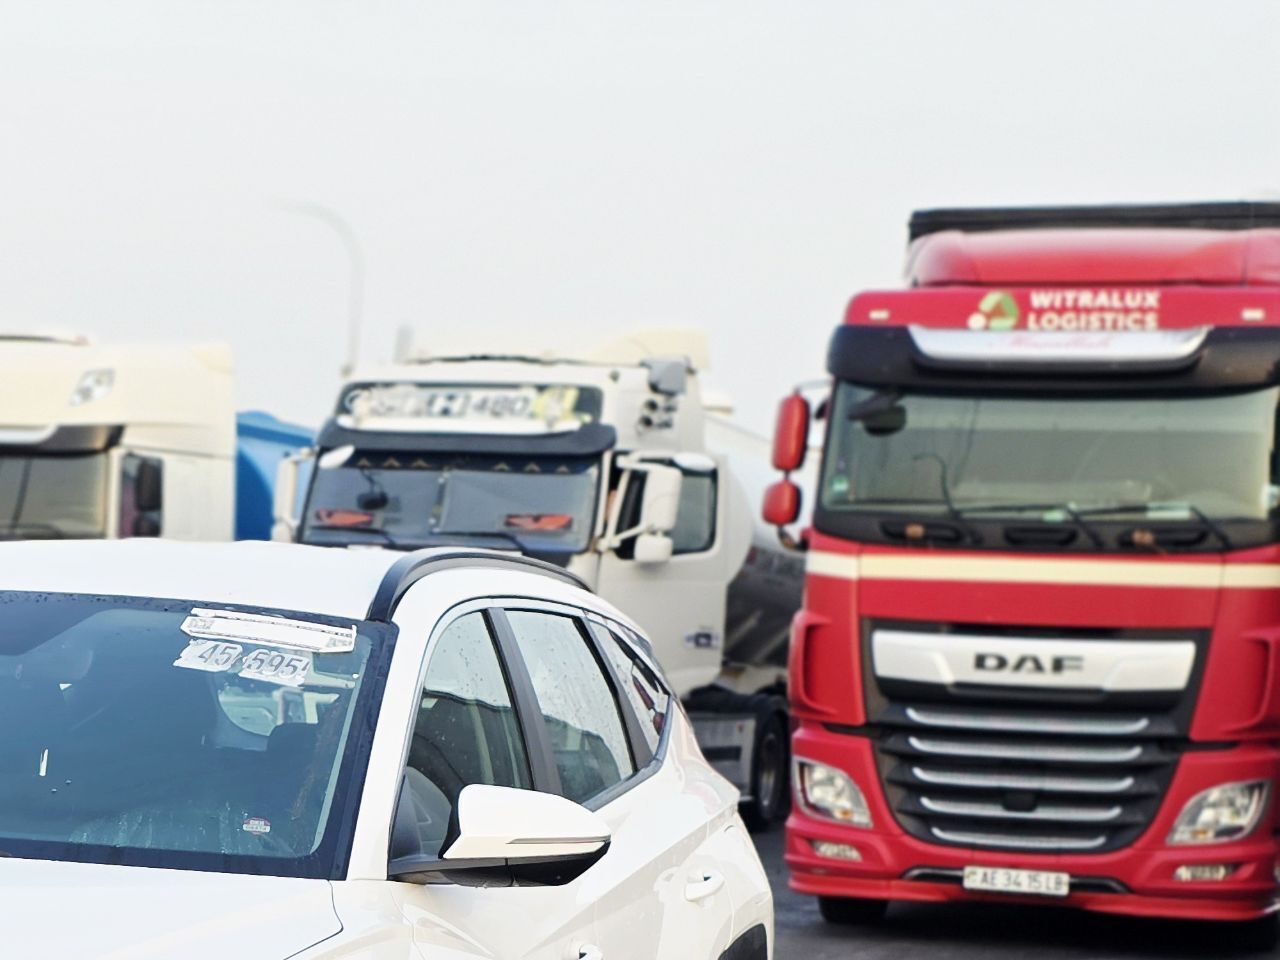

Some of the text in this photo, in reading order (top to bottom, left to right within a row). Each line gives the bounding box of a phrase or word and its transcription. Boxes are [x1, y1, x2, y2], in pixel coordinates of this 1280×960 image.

[1030, 290, 1159, 309] WITRALUX
[1026, 311, 1159, 332] LOGISTICS
[973, 652, 1084, 674] DAF
